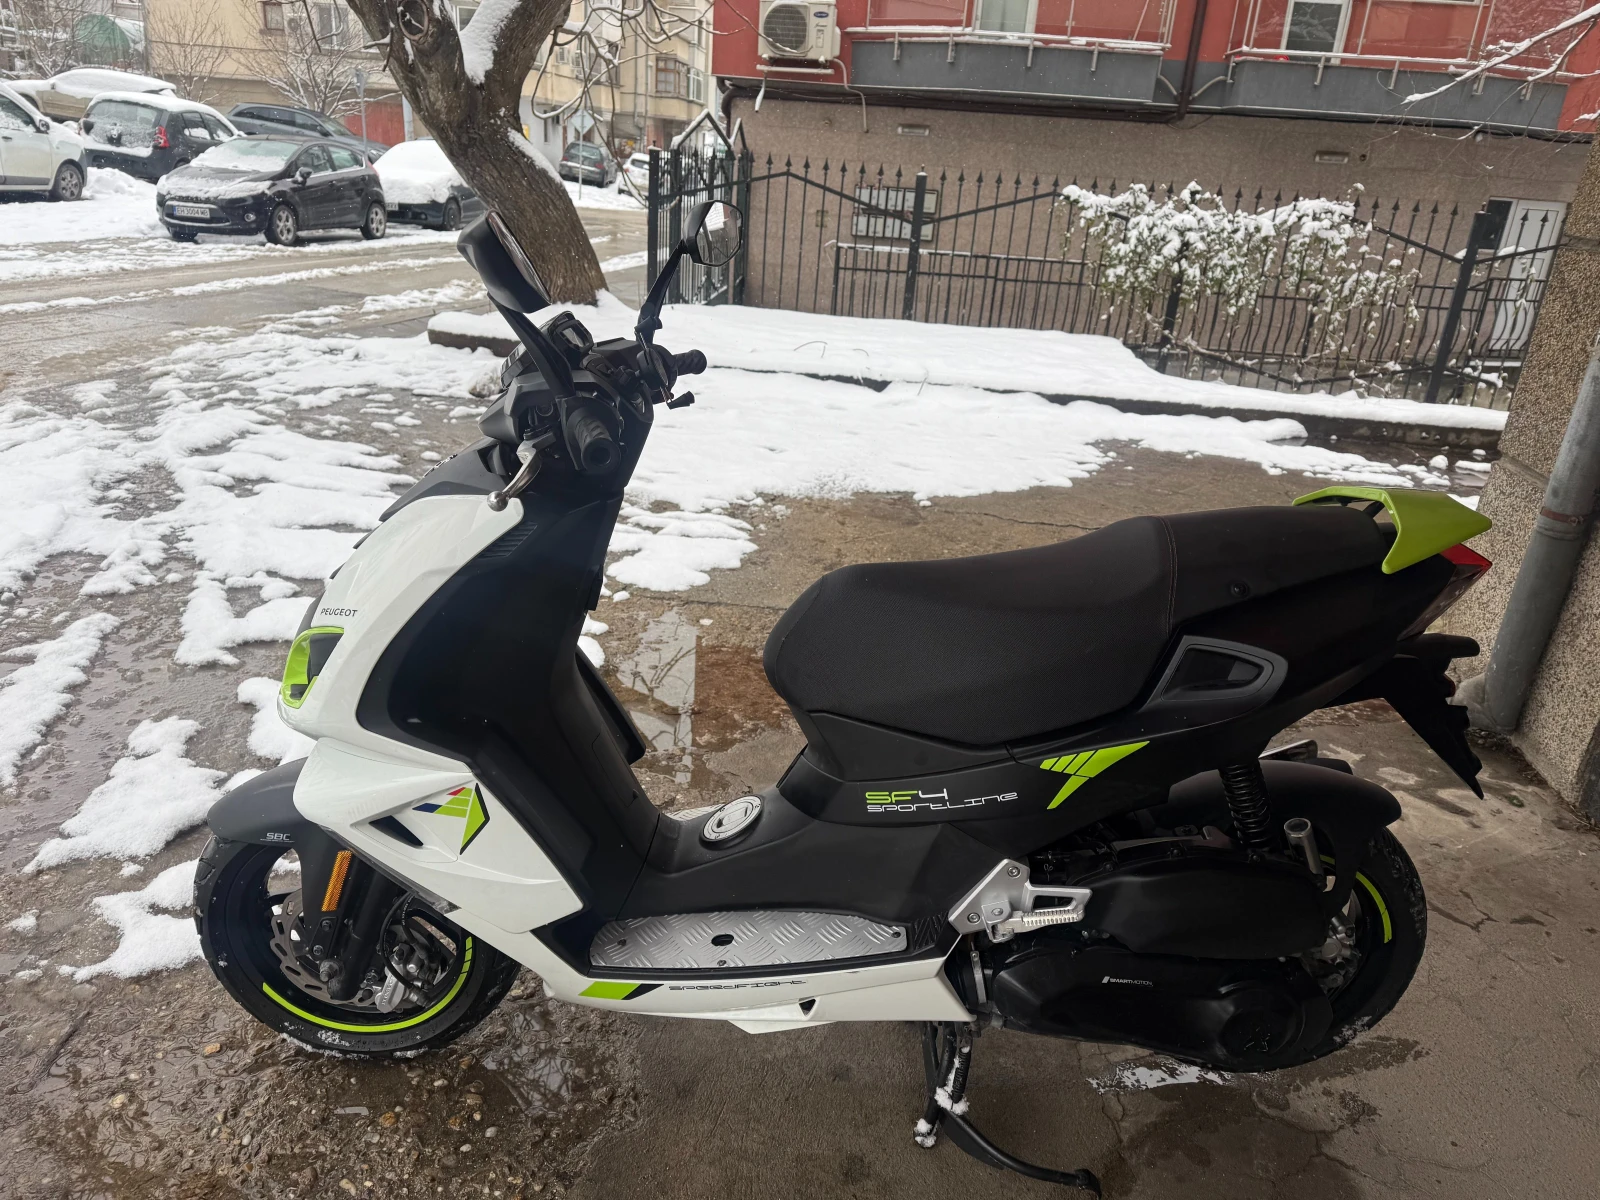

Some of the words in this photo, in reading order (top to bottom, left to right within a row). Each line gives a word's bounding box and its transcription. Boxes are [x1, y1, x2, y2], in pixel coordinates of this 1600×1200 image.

[320, 607, 358, 617] PEUGEOT
[865, 788, 949, 803] SF4
[266, 832, 291, 841] SBC
